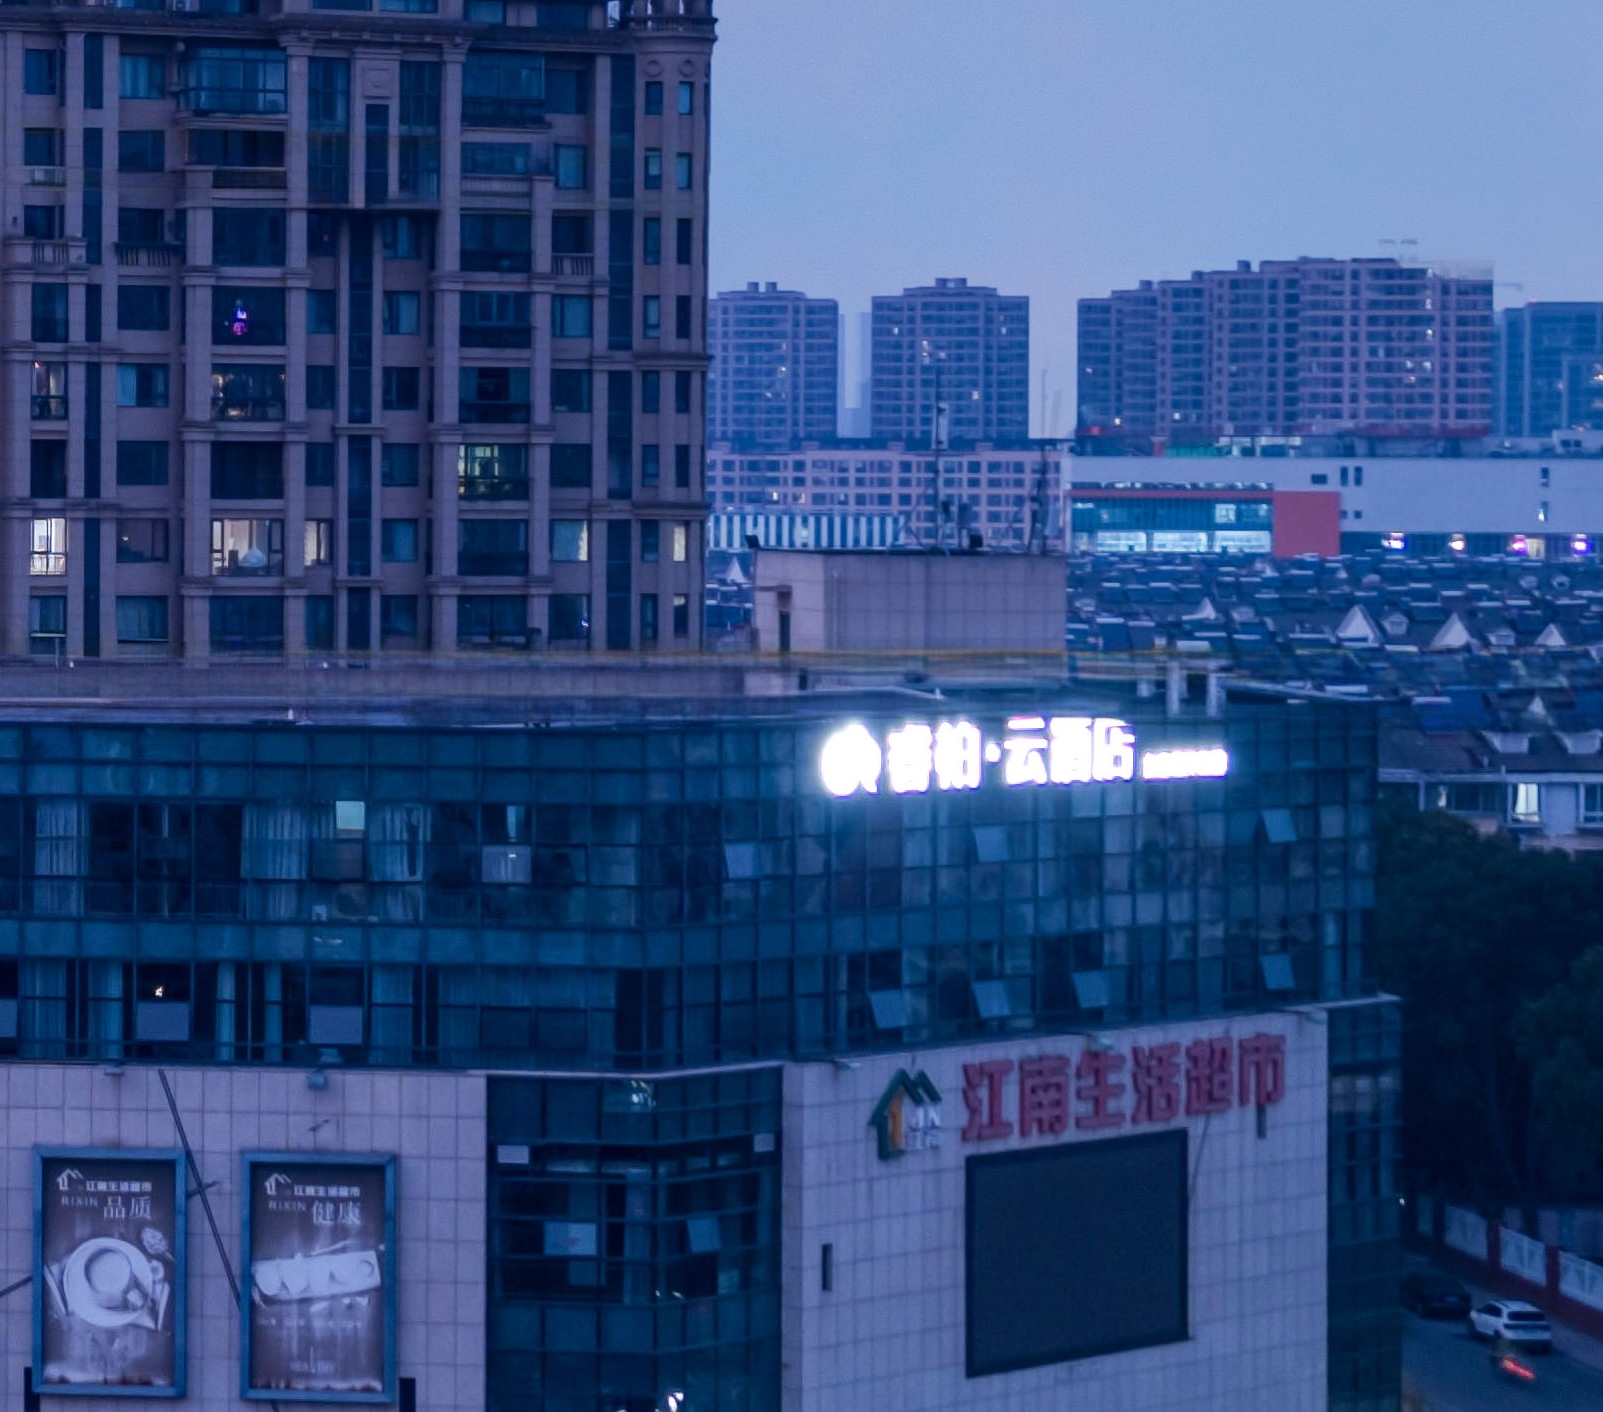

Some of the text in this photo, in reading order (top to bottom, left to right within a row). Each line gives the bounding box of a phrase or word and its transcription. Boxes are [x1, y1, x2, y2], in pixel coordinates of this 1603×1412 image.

[961, 1032, 1287, 1144] 江南生活超市
[103, 1195, 153, 1220] 品质
[312, 1199, 362, 1225] 健康
